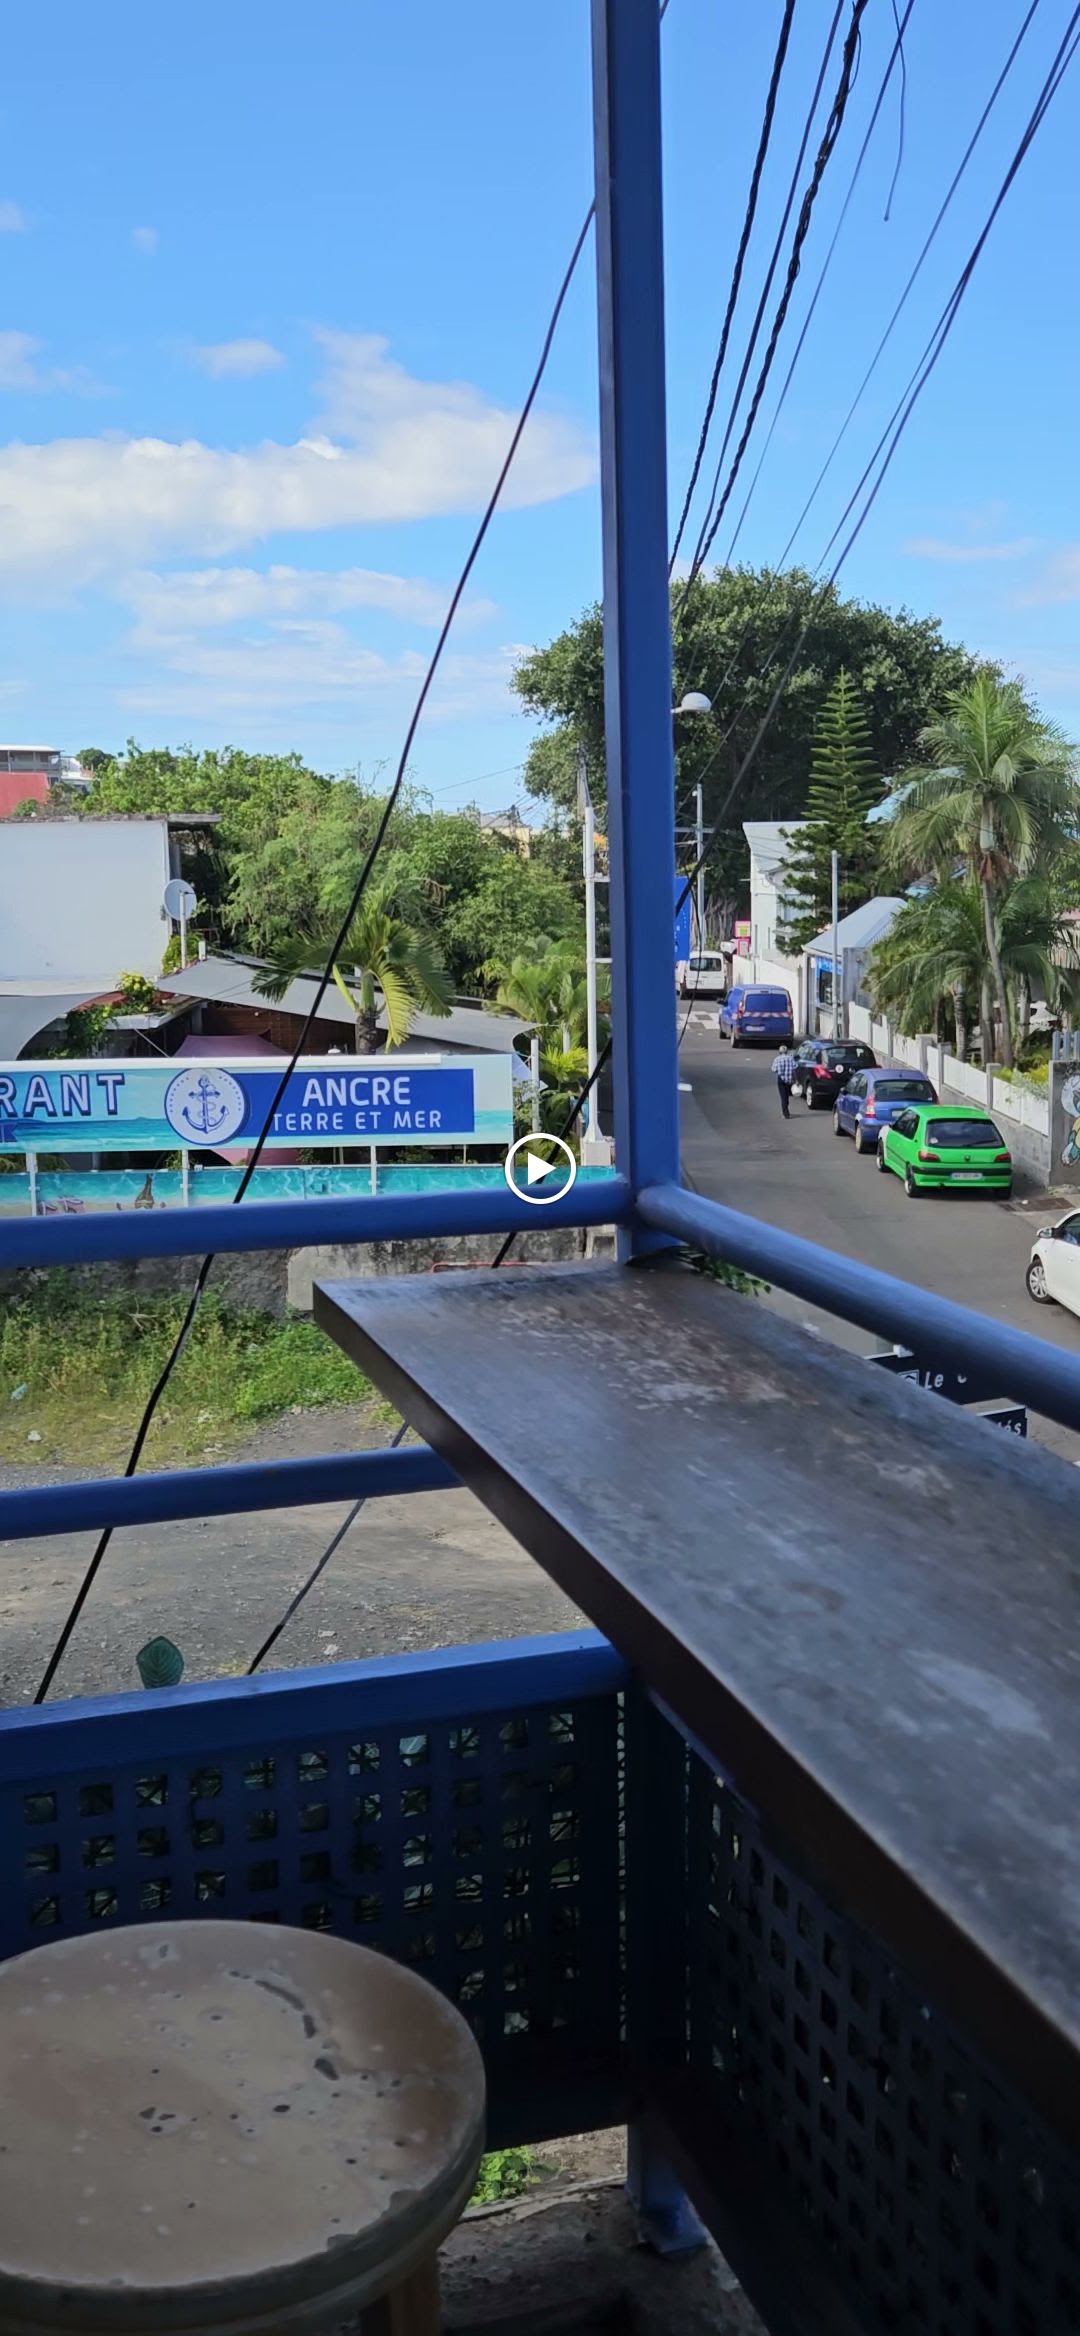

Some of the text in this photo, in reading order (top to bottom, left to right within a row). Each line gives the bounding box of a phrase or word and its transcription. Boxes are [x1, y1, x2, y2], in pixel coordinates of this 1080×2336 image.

[302, 1076, 411, 1107] ANCRE
[273, 1110, 442, 1132] TERRE ET MER
[924, 1371, 944, 1390] Le
